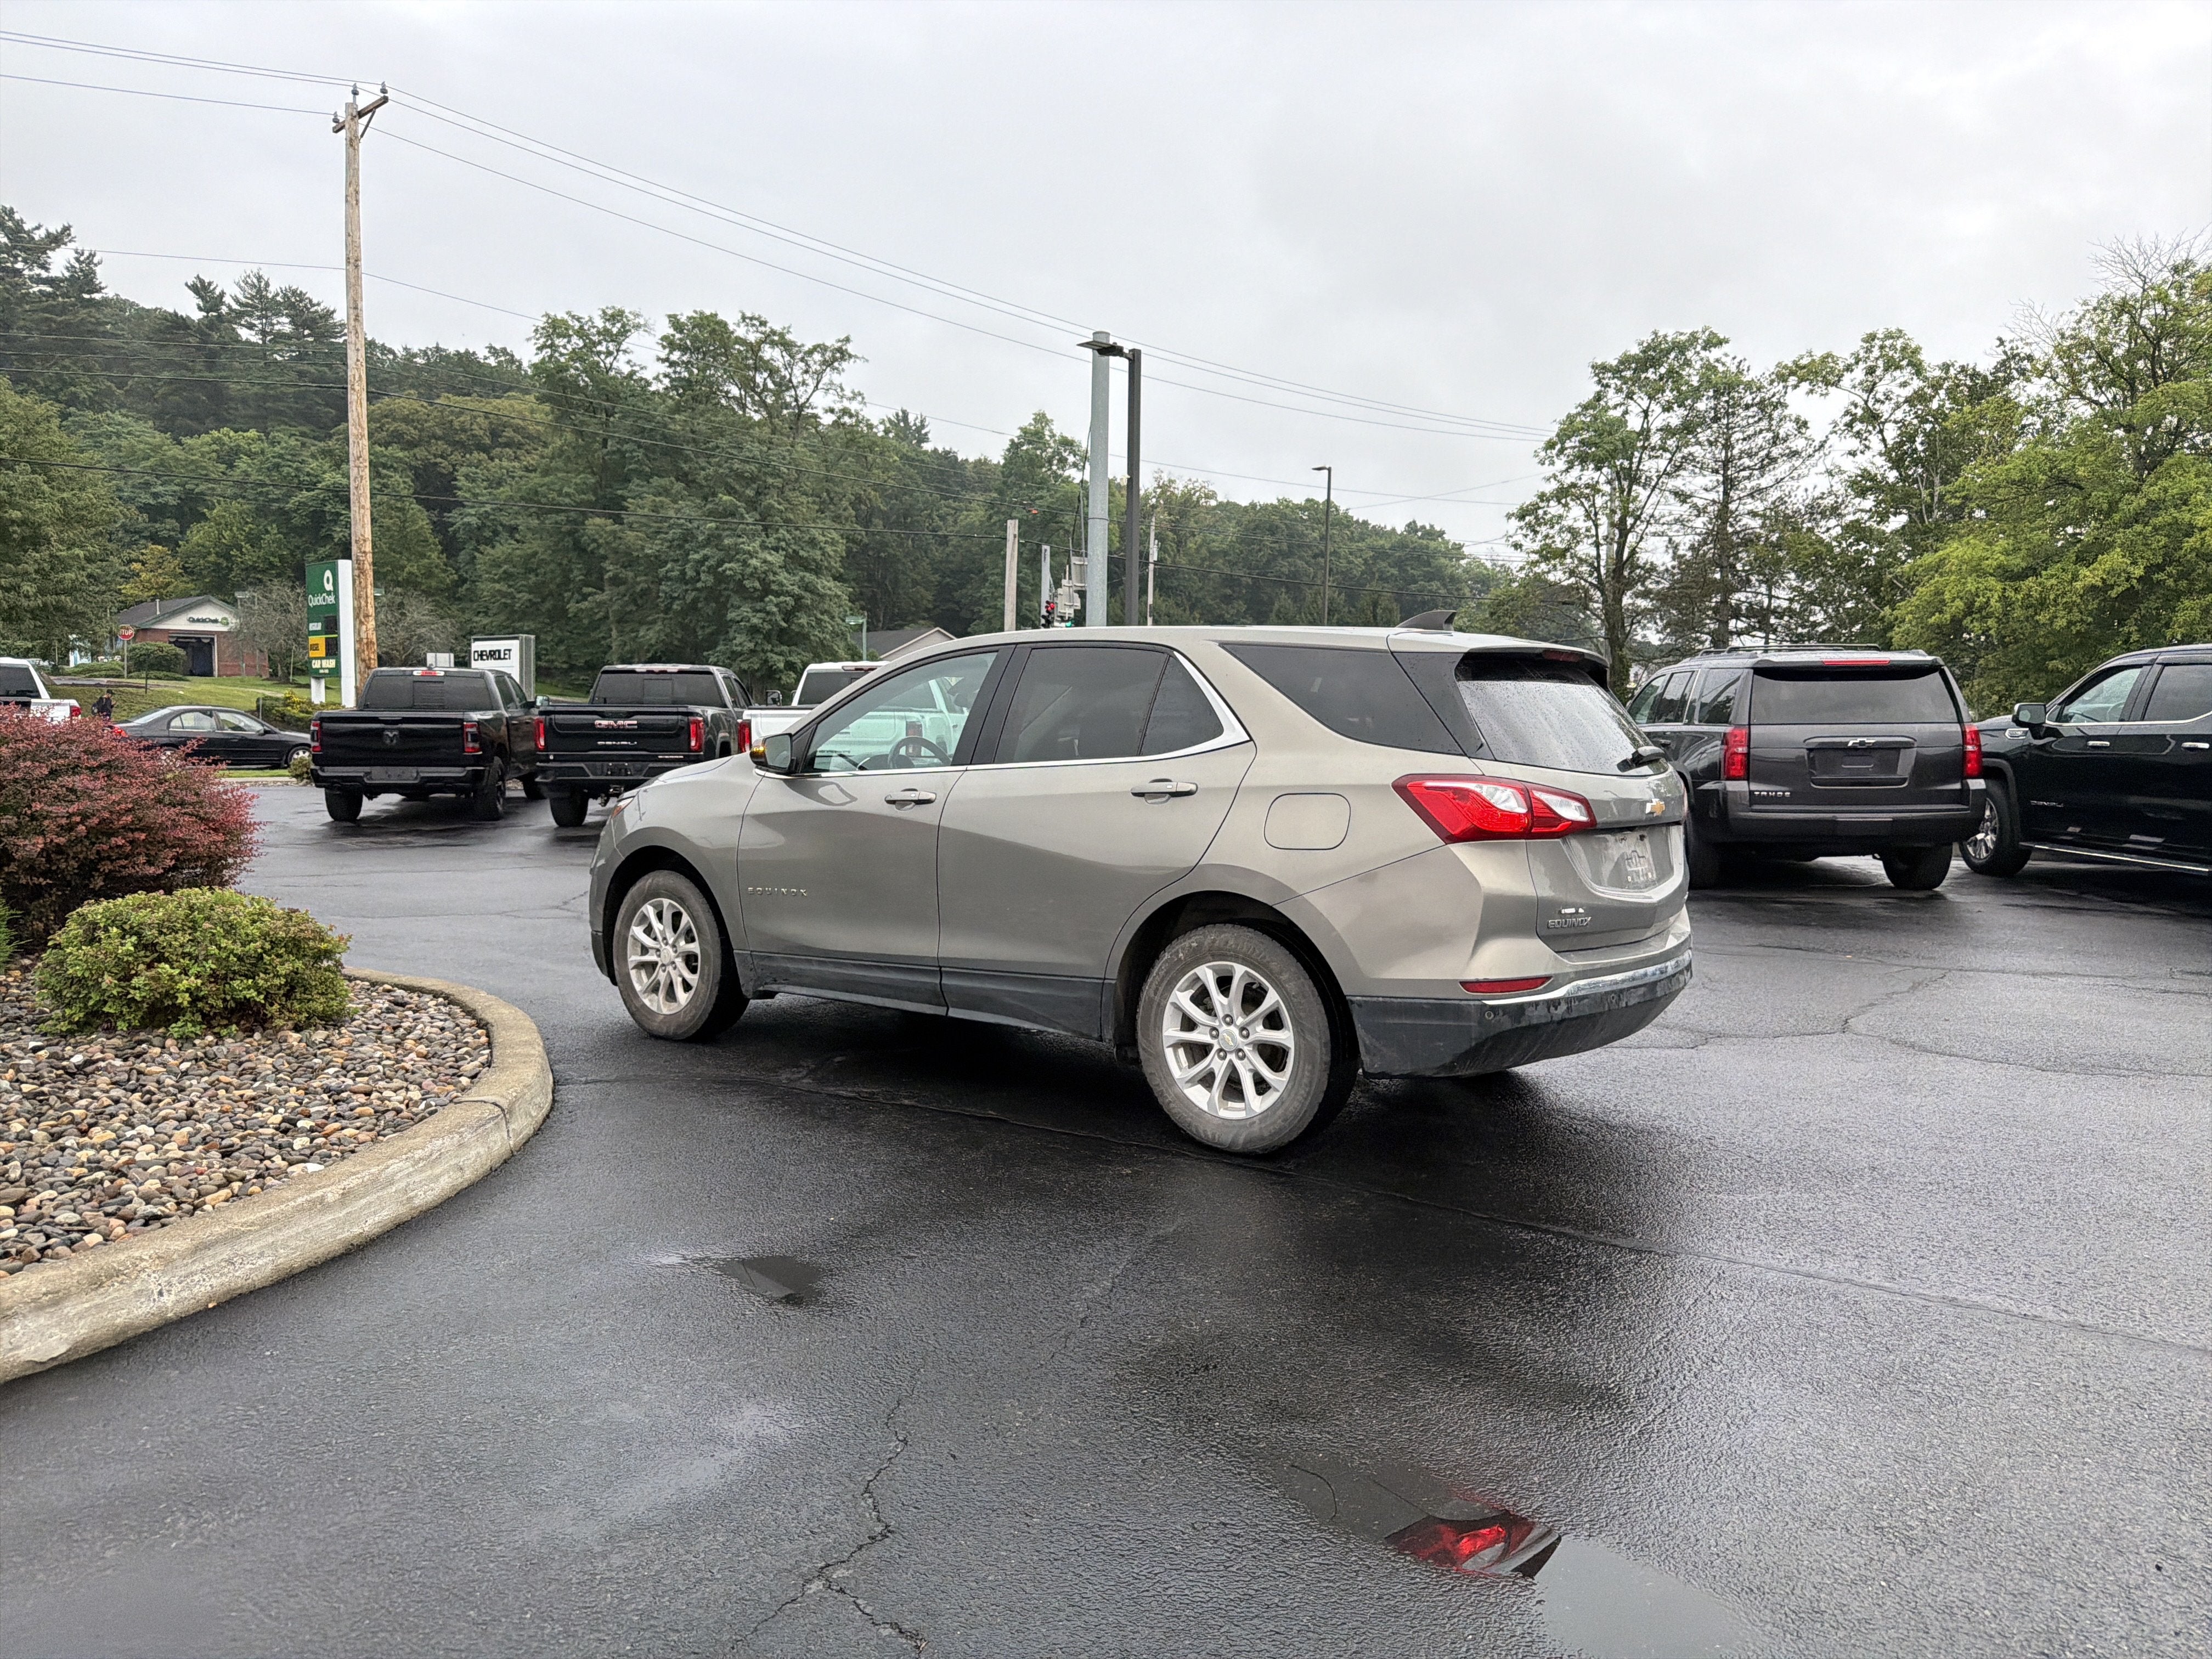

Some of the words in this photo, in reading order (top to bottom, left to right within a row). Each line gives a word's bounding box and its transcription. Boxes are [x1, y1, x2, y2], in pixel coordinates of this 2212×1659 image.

[324, 569, 334, 591] Q
[308, 592, 336, 608] QuickChek
[473, 648, 512, 662] CHEVROLET
[312, 659, 321, 669] CAR
[321, 659, 336, 668] WASH
[594, 720, 638, 729] GMC
[748, 887, 807, 896] EQUINOX
[1548, 916, 1592, 929] EQUINOX
